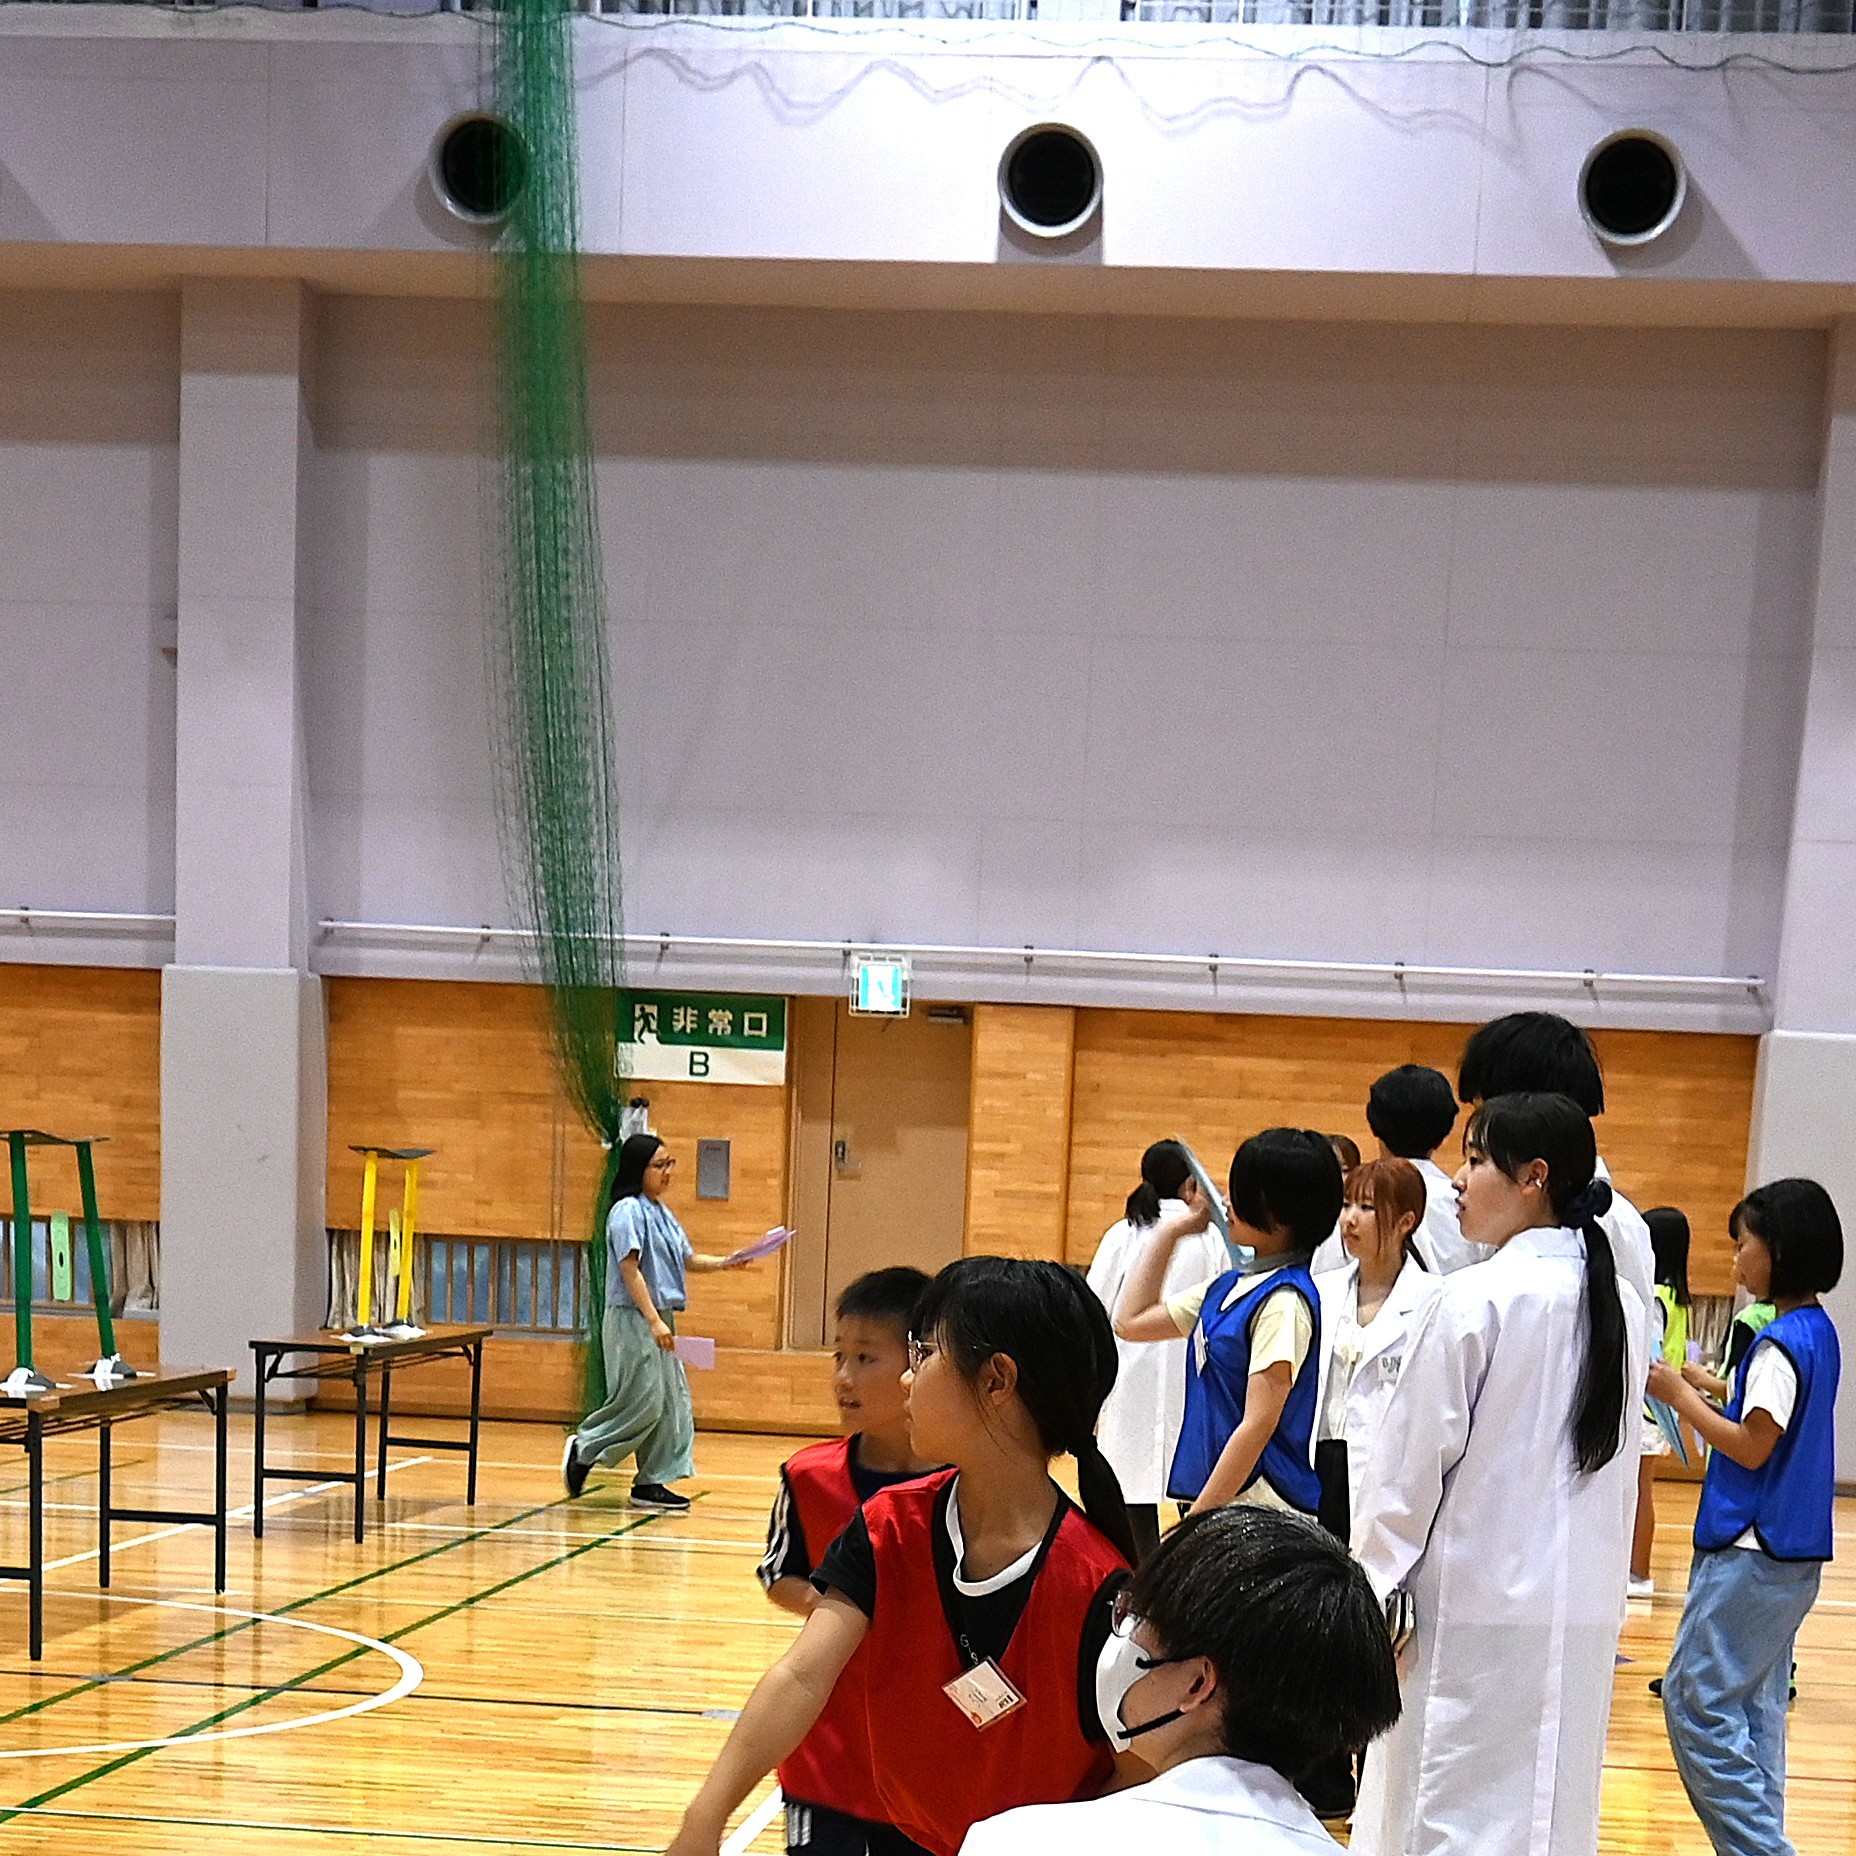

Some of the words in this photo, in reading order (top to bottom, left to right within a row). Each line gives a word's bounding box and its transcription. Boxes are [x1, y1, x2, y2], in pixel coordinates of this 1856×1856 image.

[672, 1006, 768, 1038] 非常口
[689, 1050, 710, 1077] B
